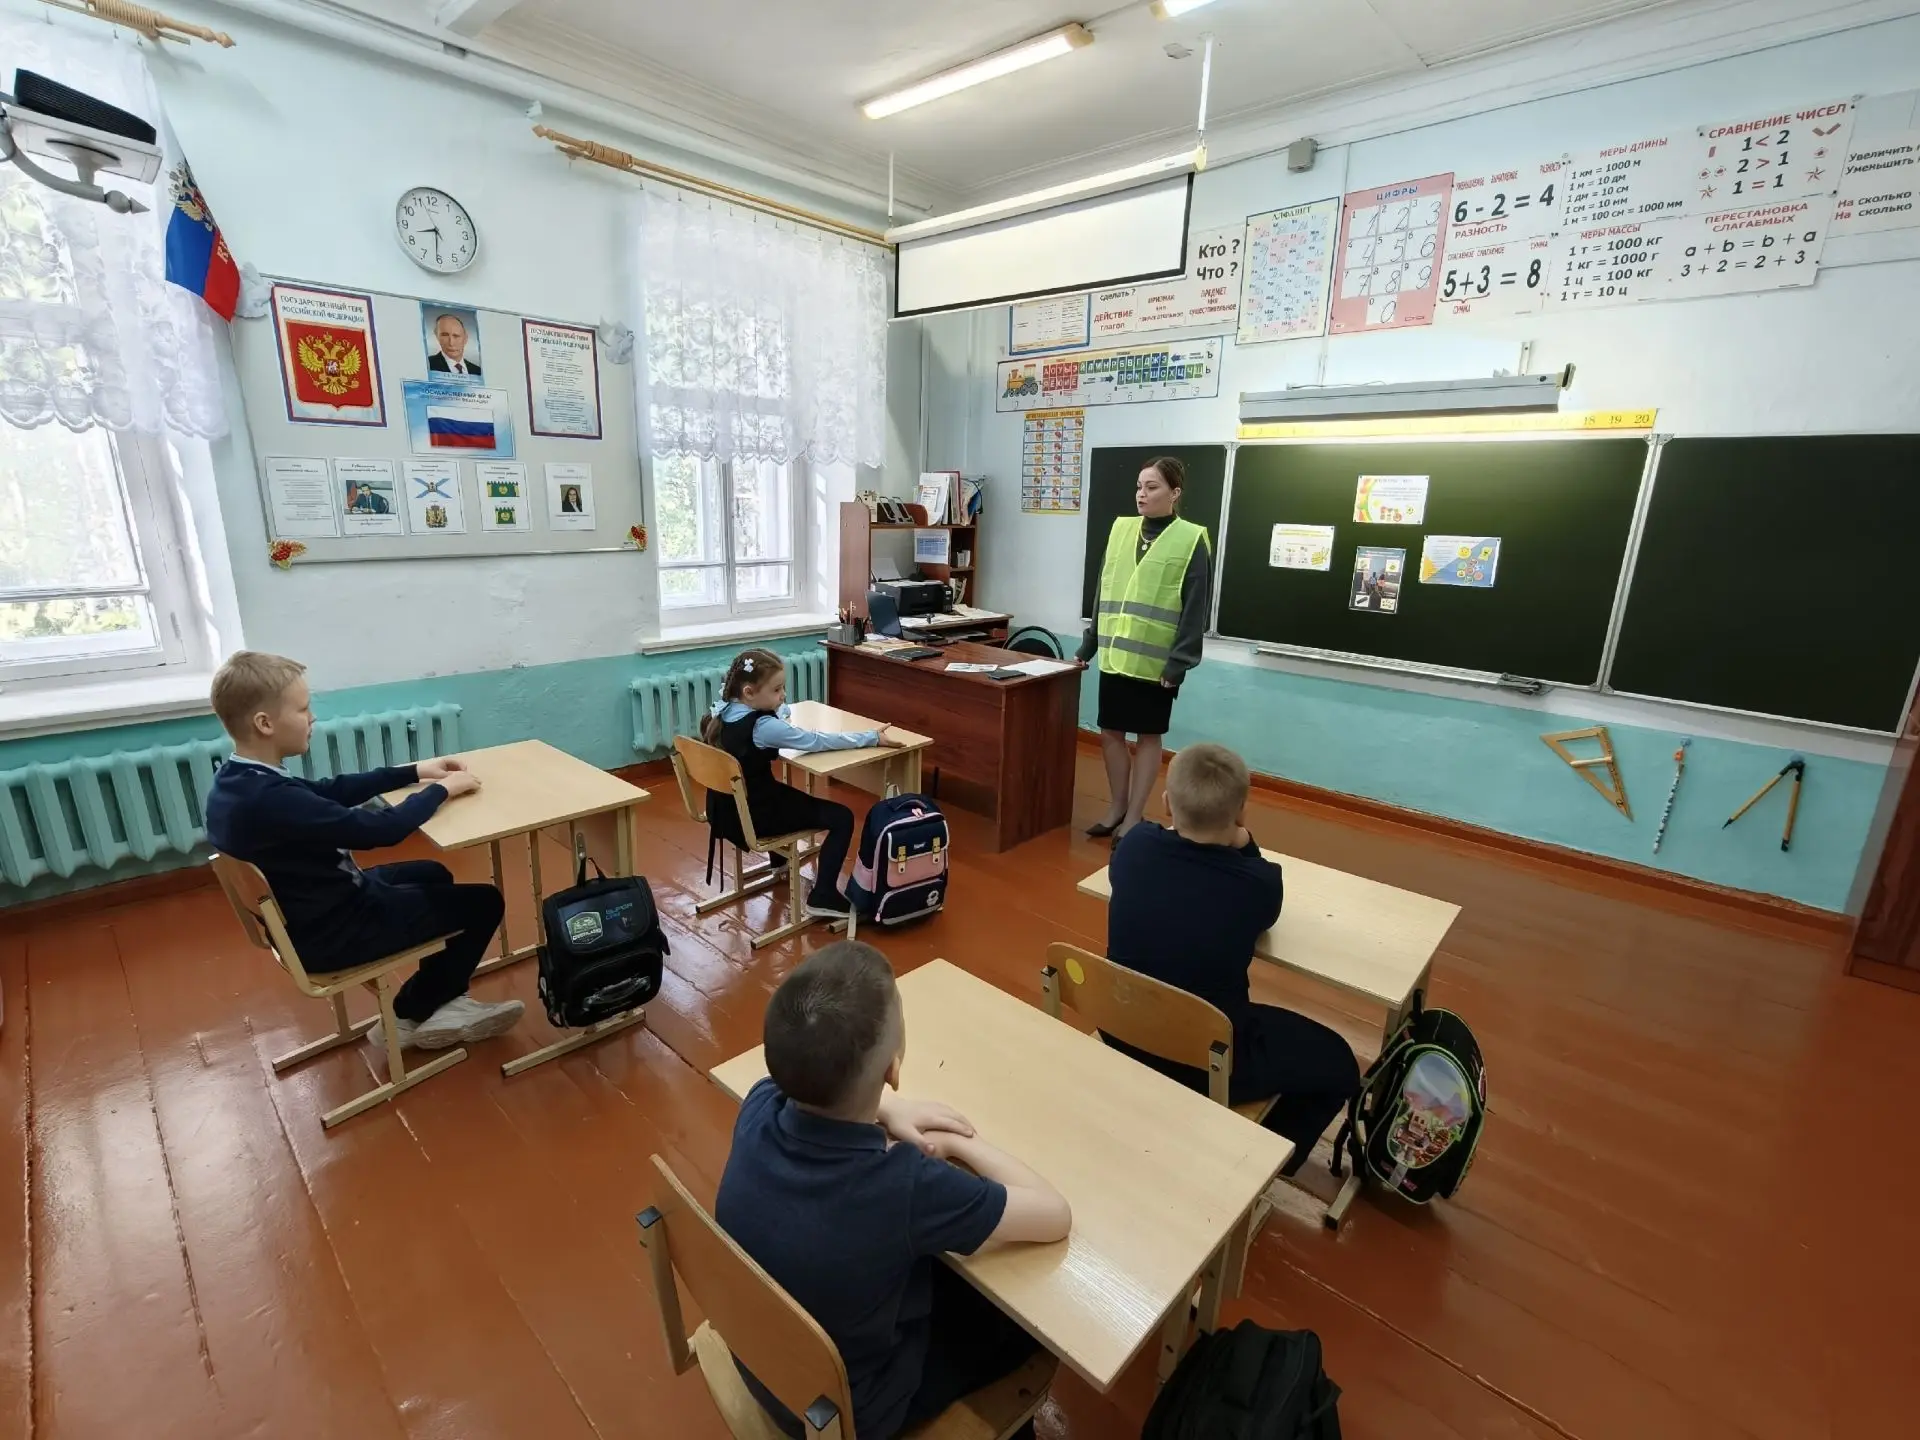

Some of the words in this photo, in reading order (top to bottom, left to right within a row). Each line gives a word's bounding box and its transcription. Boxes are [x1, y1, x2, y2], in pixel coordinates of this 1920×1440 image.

[1709, 114, 1791, 138] СРАВНЕНИЕ
[1796, 103, 1846, 121] ЧИСЕЛ
[1600, 146, 1627, 158] МЕРЫ
[1630, 138, 1667, 153] ДЛИНЫ
[1742, 137, 1752, 151] 1
[1756, 135, 1770, 146] <
[1776, 130, 1790, 145] 2
[1849, 145, 1913, 162] Увеличить
[1606, 160, 1631, 172] 1000
[1737, 159, 1749, 173] 2
[1756, 158, 1770, 170] >
[1778, 151, 1788, 166] 1
[1846, 158, 1914, 175] Уменьшить
[1598, 176, 1609, 185] 10
[1611, 174, 1626, 183] дм
[1732, 180, 1743, 194] 1
[1752, 181, 1765, 189] =
[1773, 174, 1784, 188] 1
[426, 196, 437, 207] 12
[1377, 186, 1418, 201] ЦИФРЫ
[1574, 193, 1588, 202] дм
[1602, 187, 1613, 196] 10
[1838, 200, 1854, 208] На
[1858, 192, 1912, 205] сколько
[412, 197, 422, 207] 11
[446, 204, 450, 213] 1
[1455, 201, 1468, 222] 6
[1491, 193, 1506, 216] 2
[1514, 195, 1530, 208] =
[1539, 184, 1554, 206] 4
[1573, 205, 1585, 213] см
[1598, 199, 1610, 208] 10
[1613, 197, 1628, 206] мм
[403, 206, 414, 216] 10
[1272, 206, 1312, 221] АЛФАВИТ
[1367, 211, 1379, 236] 1
[1381, 205, 1387, 213] 2
[1394, 207, 1410, 232] 2
[1412, 199, 1418, 207] 3
[1426, 201, 1441, 225] 3
[1563, 218, 1568, 226] 1
[1592, 211, 1609, 221] 100
[1611, 209, 1624, 218] см
[1639, 202, 1664, 213] 1000
[1705, 202, 1809, 224] ПЕРЕСТАНОВКА
[1835, 212, 1851, 220] На
[1858, 203, 1912, 216] сколько
[402, 220, 408, 229] 9
[455, 216, 462, 225] 2
[1712, 214, 1795, 233] СЛАГАЕМЫХ
[462, 231, 468, 240] 3
[1455, 224, 1508, 239] РАЗНОСТЬ
[1581, 228, 1606, 240] МЕРЫ
[1608, 223, 1641, 235] МАССЫ
[409, 235, 415, 245] 8
[1569, 247, 1576, 256] 1
[1607, 237, 1642, 251] 1000
[1647, 236, 1663, 246] кг
[1685, 246, 1697, 257] a
[1704, 243, 1715, 254] +
[1722, 239, 1734, 252] b
[1762, 235, 1774, 248] b
[1783, 233, 1795, 244] +
[1803, 231, 1817, 242] a
[421, 248, 427, 258] 7
[460, 245, 466, 253] 4
[1199, 244, 1226, 259] Кто
[1231, 239, 1240, 254] ?
[1362, 244, 1374, 266] 4
[1377, 237, 1383, 245] 5
[1390, 239, 1405, 262] 5
[1408, 231, 1413, 240] 6
[1421, 234, 1436, 258] 6
[436, 255, 442, 265] 6
[451, 253, 458, 262] 5
[1566, 261, 1572, 271] 1
[1578, 260, 1592, 270] кг
[1612, 252, 1647, 265] 1000
[1681, 264, 1691, 277] 3
[1698, 264, 1709, 275] +
[1716, 260, 1728, 272] 2
[1754, 255, 1766, 268] 2
[1774, 255, 1786, 266] +
[1795, 250, 1805, 264] 3
[1196, 266, 1224, 280] Что
[1230, 262, 1238, 276] ?
[1500, 272, 1517, 285] =
[1527, 259, 1542, 288] 8
[1563, 276, 1570, 286] 1
[1575, 276, 1584, 285] ц
[1607, 269, 1632, 281] 100
[1637, 268, 1653, 277] кг
[1358, 274, 1371, 297] 7
[1373, 267, 1379, 275] 8
[1385, 270, 1400, 293] 8
[1416, 265, 1432, 290] 9
[1100, 292, 1130, 301] сделать
[1200, 287, 1228, 298] ПРЕДМЕТ
[1561, 291, 1568, 301] 1
[1598, 286, 1614, 297] 10
[1618, 286, 1628, 296] ц
[280, 295, 347, 310] ГОСУДАРСТВЕННЫЙ
[282, 306, 326, 317] РОССИЙСКОЙ
[1094, 310, 1133, 323] ДЕЙСТВИЕ
[1380, 301, 1396, 323] 0
[1100, 322, 1125, 332] глагол
[1584, 415, 1596, 425] 18
[1609, 415, 1622, 424] 19
[1634, 414, 1650, 423] 20
